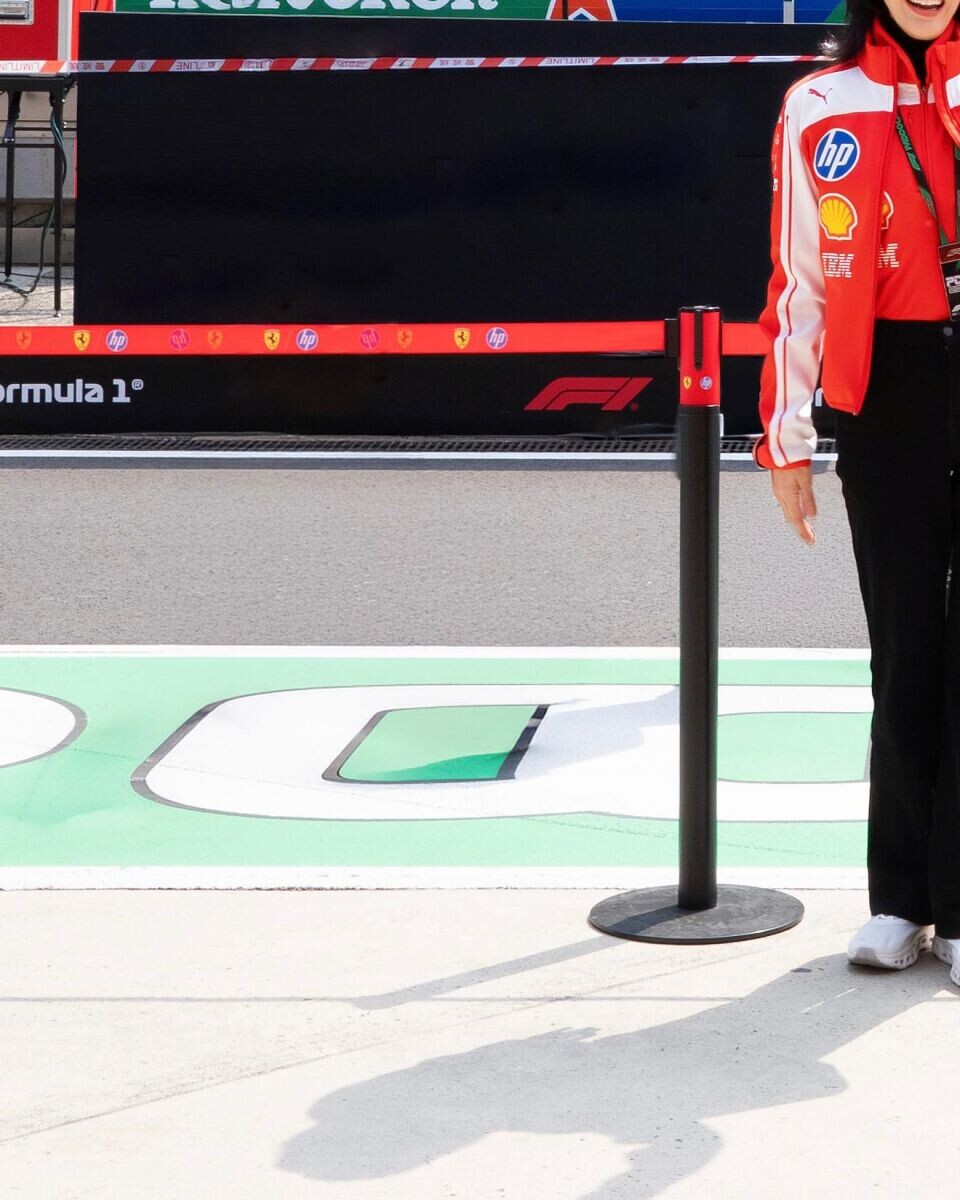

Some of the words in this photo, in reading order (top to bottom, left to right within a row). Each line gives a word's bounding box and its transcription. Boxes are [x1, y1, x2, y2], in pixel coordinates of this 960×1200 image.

[817, 129, 855, 180] hp
[822, 252, 855, 278] IBM
[108, 330, 127, 351] hp
[298, 330, 317, 351] hp
[488, 328, 507, 348] hp
